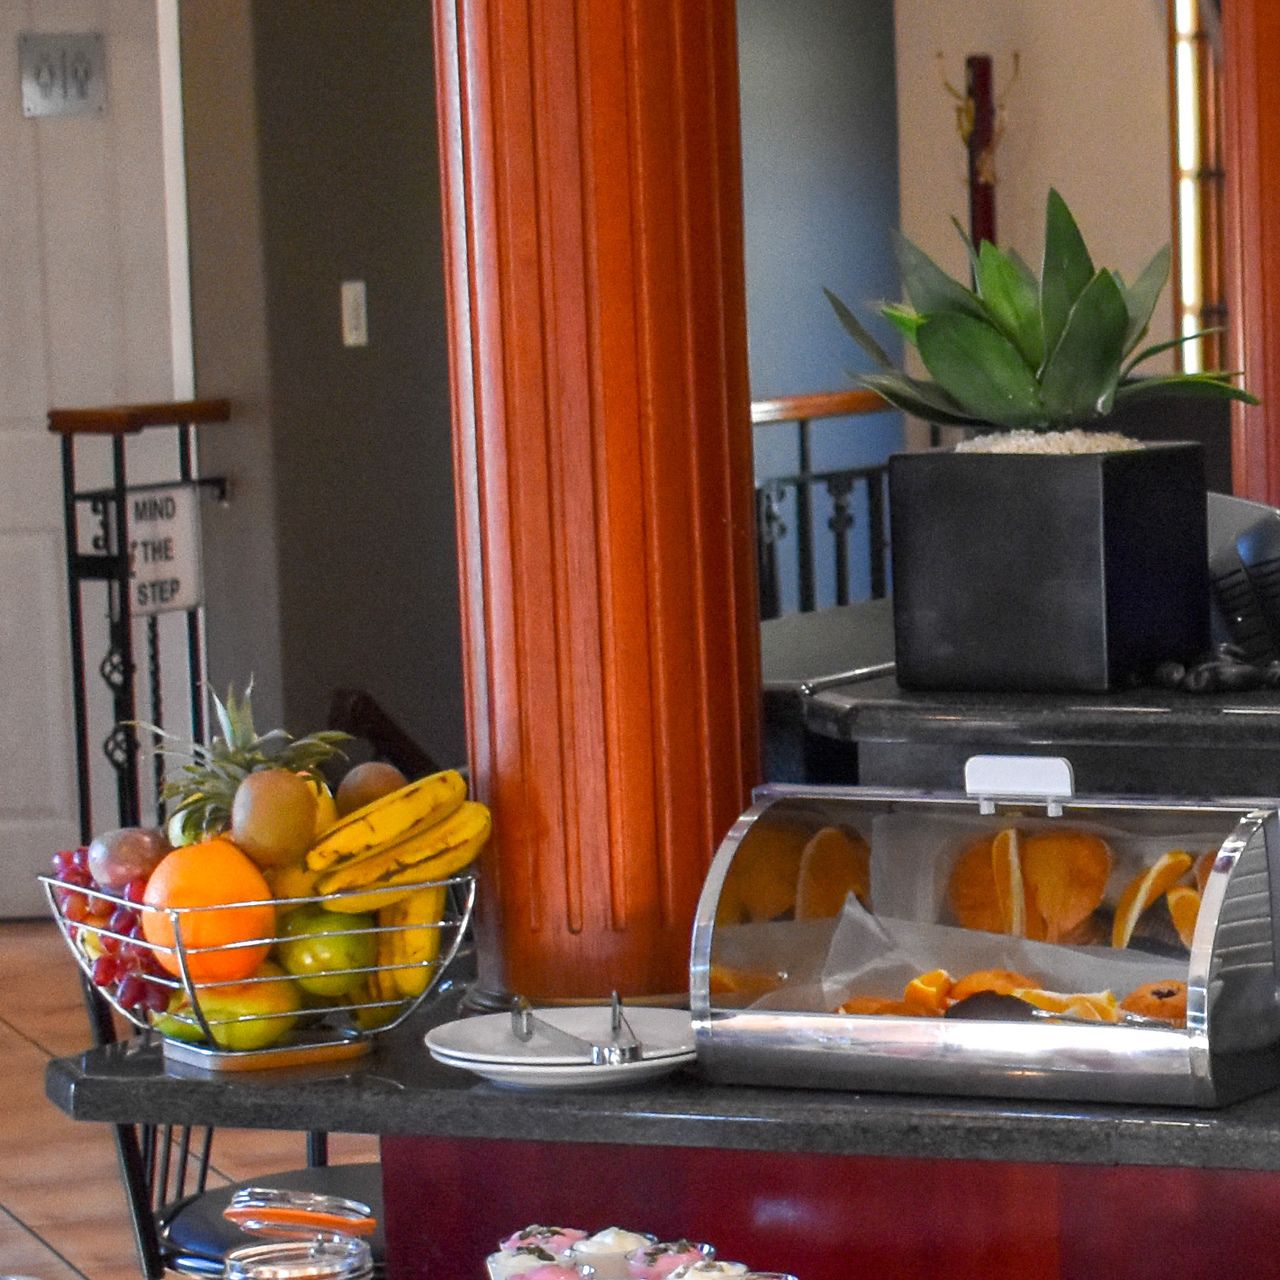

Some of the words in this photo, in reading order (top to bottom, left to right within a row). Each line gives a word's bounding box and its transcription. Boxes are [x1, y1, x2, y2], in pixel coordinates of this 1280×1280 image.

[134, 496, 176, 521] MIND
[141, 538, 174, 562] THE
[137, 579, 180, 606] STEP
